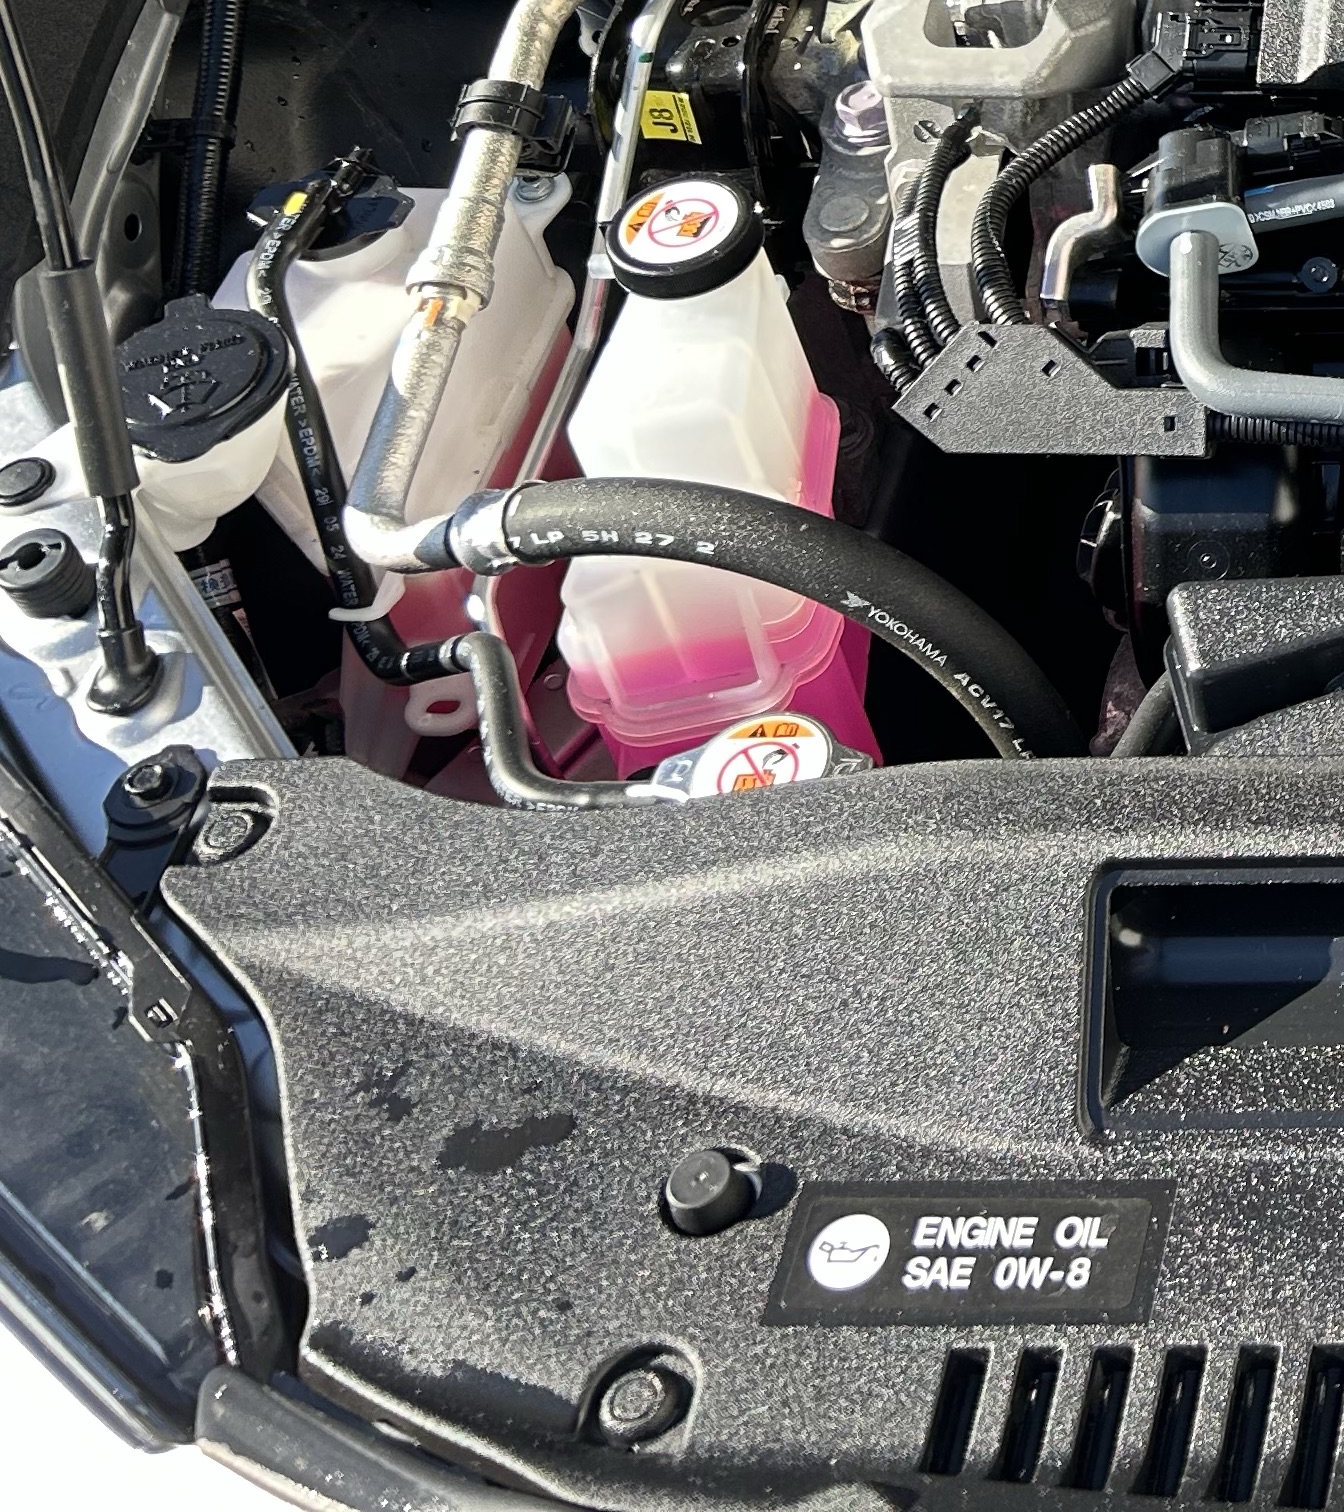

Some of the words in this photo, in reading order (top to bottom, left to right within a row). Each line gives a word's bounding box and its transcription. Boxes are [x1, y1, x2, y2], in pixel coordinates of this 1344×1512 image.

[648, 106, 679, 135] J8
[529, 529, 564, 546] LP
[582, 529, 620, 544] 5H
[634, 531, 675, 547] 27
[866, 604, 949, 669] YOKOHAMA
[952, 671, 1016, 731] ACV17
[911, 1215, 1039, 1250] ENGINE
[1053, 1215, 1110, 1249] OIL
[901, 1255, 977, 1291] SAE
[992, 1256, 1092, 1291] 0W-8
